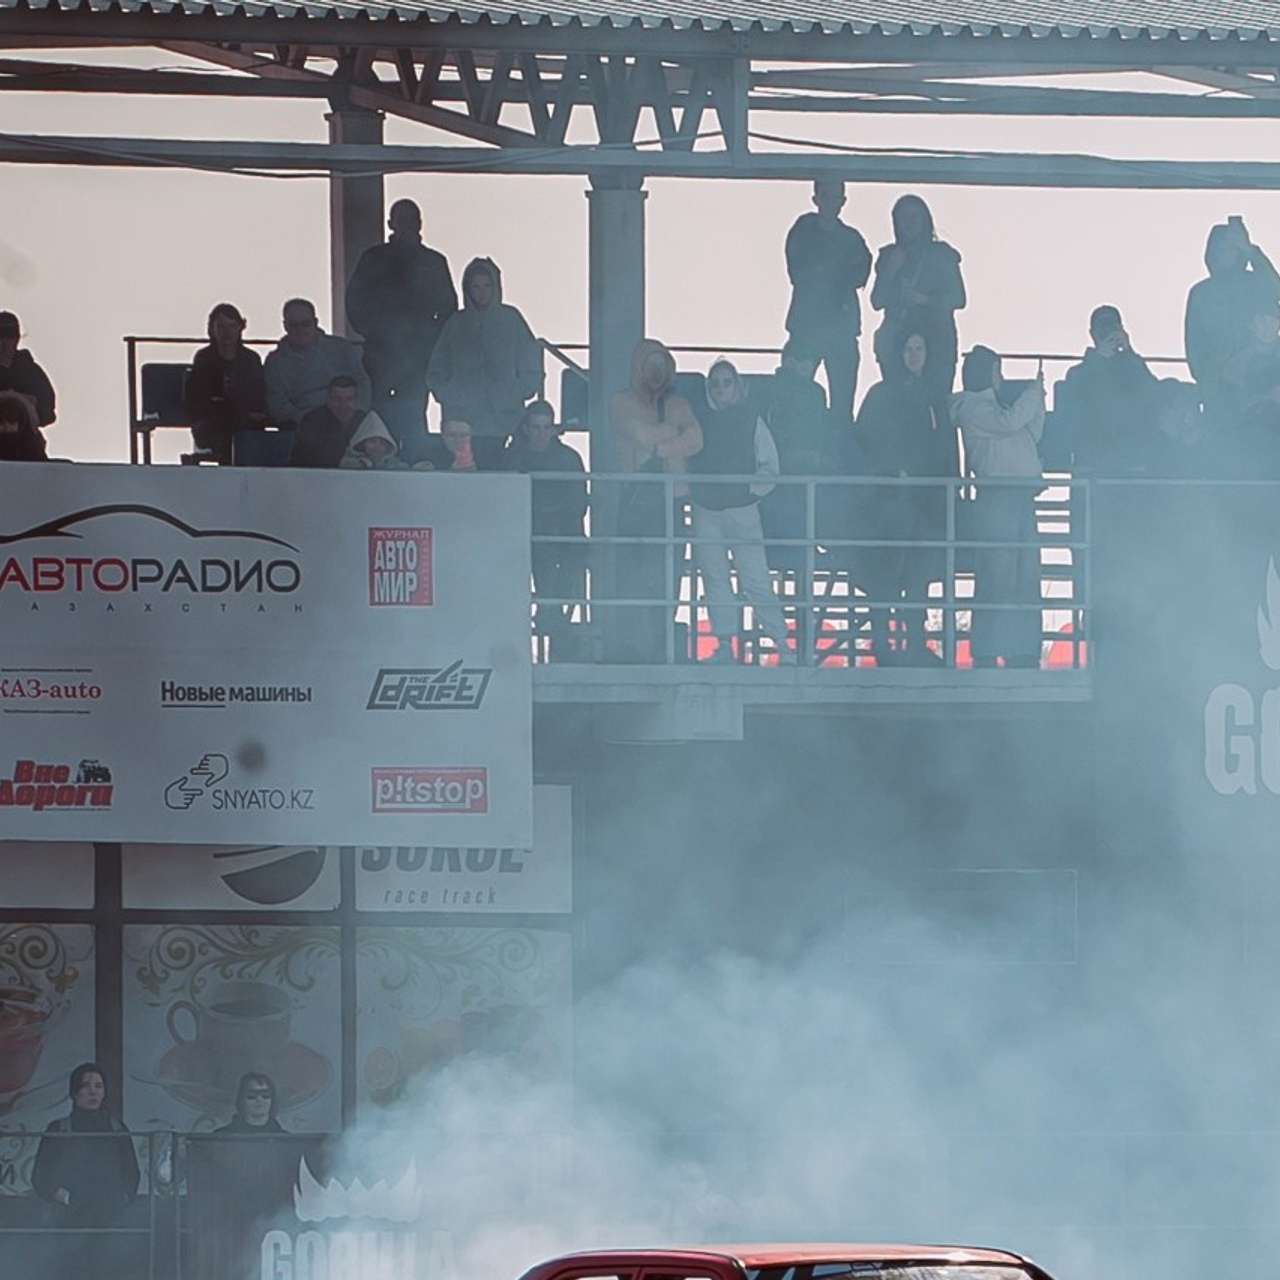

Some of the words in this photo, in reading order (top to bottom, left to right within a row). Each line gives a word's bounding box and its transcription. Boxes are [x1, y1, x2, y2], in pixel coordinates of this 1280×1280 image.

[373, 540, 418, 570] АВТО
[373, 571, 418, 603] МИР
[408, 676, 431, 684] THE
[160, 681, 226, 703] Новые
[229, 686, 313, 703] машины
[13, 760, 71, 783] Вне
[211, 789, 314, 810] SNYATO.KZ
[383, 888, 429, 904] race
[442, 885, 498, 904] track
